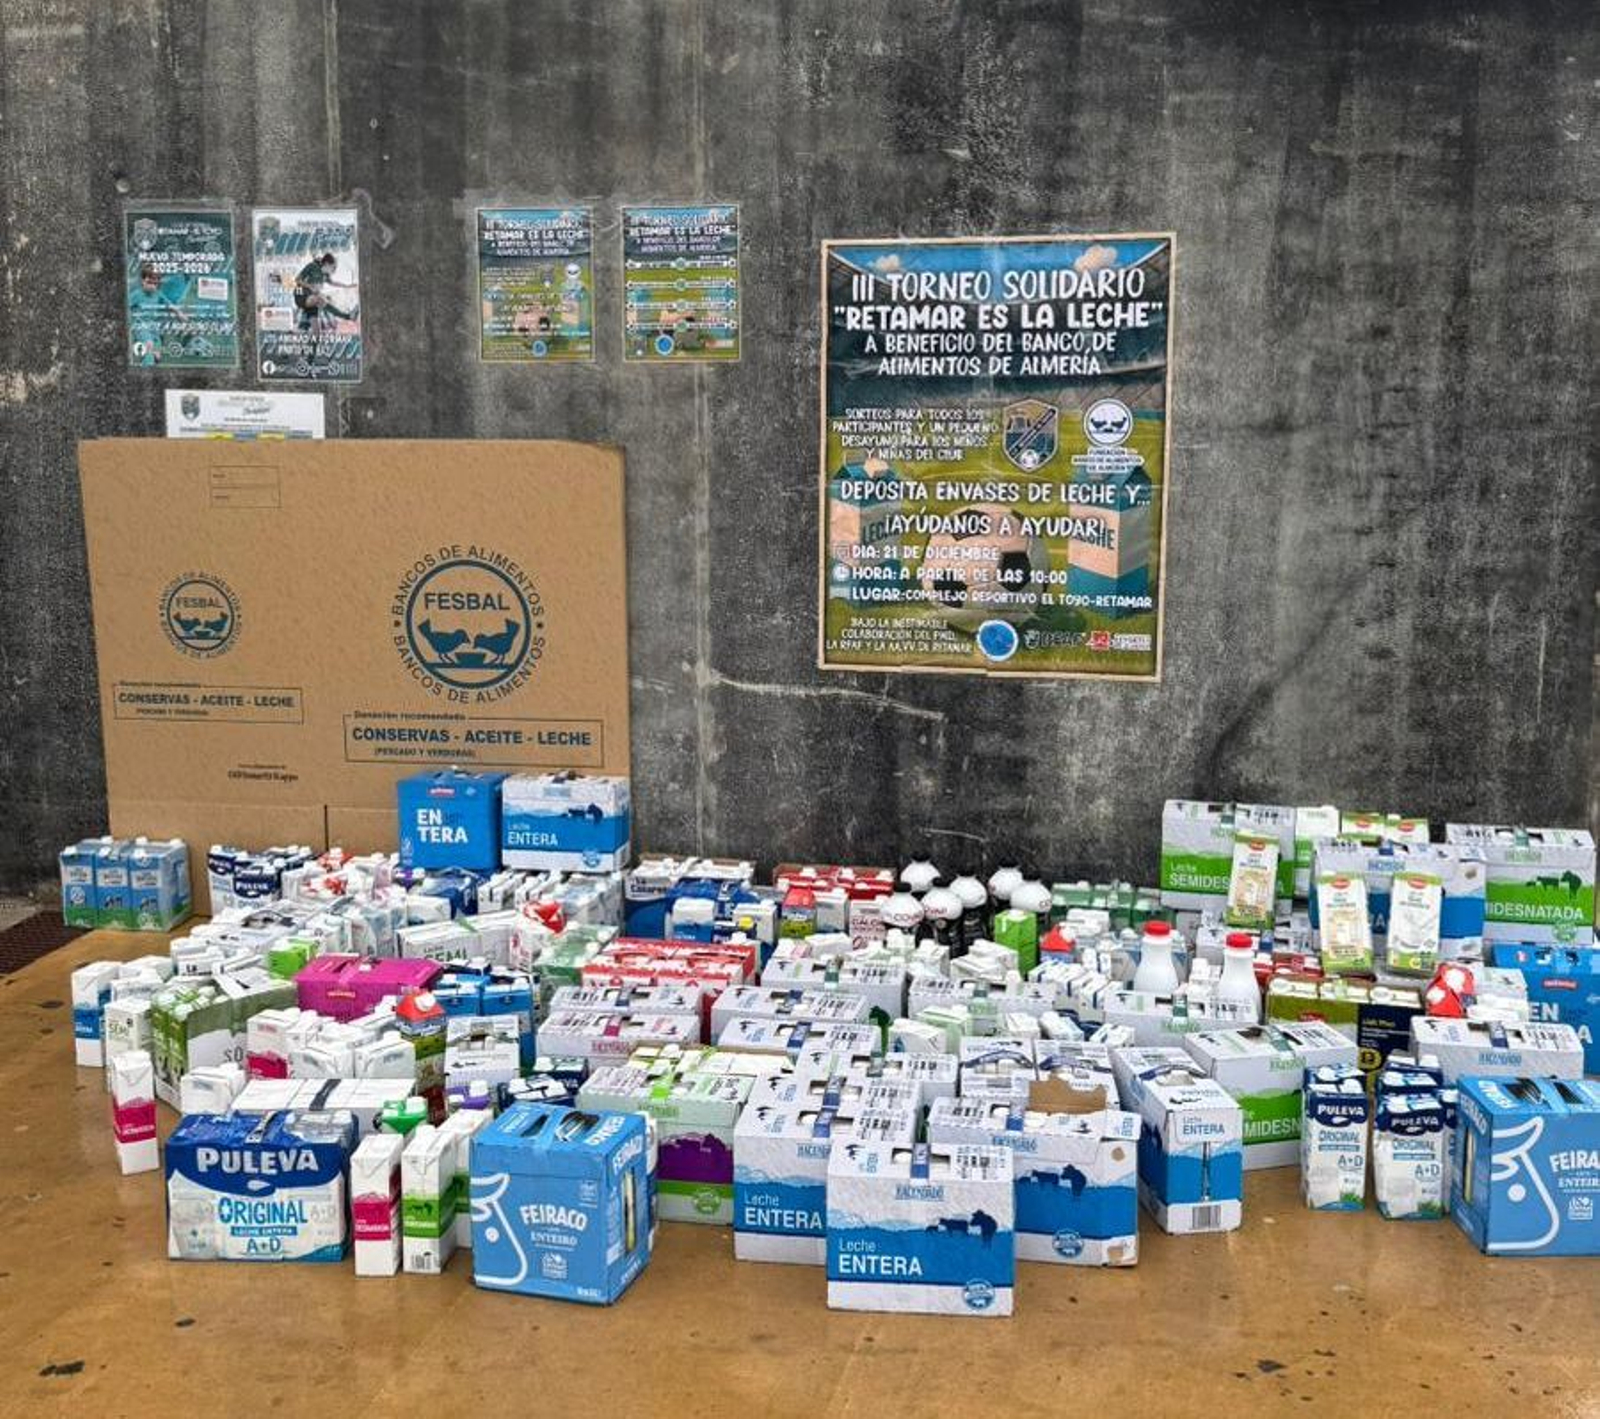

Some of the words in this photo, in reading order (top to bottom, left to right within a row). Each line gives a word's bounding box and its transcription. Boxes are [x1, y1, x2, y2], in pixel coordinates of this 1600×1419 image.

[852, 273, 874, 301] III
[886, 270, 991, 301] TORNEO
[1003, 267, 1146, 300] SOLIDARIO
[834, 304, 966, 330] "RETAMAR
[978, 303, 1009, 330] ES
[1020, 303, 1055, 329] LA
[1067, 302, 1163, 328] LECHE"
[865, 334, 878, 353] A
[885, 333, 975, 353] BENEFICIO
[982, 332, 1013, 353] DEL
[1022, 331, 1085, 352] BANCO
[1092, 331, 1117, 351] DE
[878, 356, 981, 376] ALIMENTOS
[989, 355, 1012, 375] DE
[1020, 348, 1101, 376] ALMERÍA
[845, 408, 891, 420] SORTEOS
[895, 408, 923, 420] PARA
[929, 408, 963, 420] TODOS
[967, 408, 984, 420] LOS
[833, 421, 912, 434] PARTICIPANTES
[918, 422, 927, 433] Y
[930, 422, 945, 433] UN
[841, 434, 898, 448] DESAYUNO
[901, 434, 927, 447] PARA
[932, 434, 950, 447] LOS
[866, 448, 876, 460] Y
[916, 448, 933, 460] DEL
[841, 480, 928, 500] DEPOSITA
[936, 481, 1020, 502] ENVASES
[1028, 483, 1052, 502] DE
[1061, 484, 1116, 504] LECHE
[885, 506, 992, 534] ¡AYÚDANOS
[999, 518, 1012, 535] A
[1020, 517, 1105, 537] AYUDAR!
[883, 545, 896, 559] 21
[903, 545, 921, 559] DE
[925, 546, 1000, 561] DICIEMBRE
[392, 553, 436, 616] BANCOS
[439, 544, 462, 561] DE
[468, 544, 546, 618] ALIMENTOS
[852, 566, 897, 580] HORA:
[900, 567, 910, 580] A
[916, 568, 966, 582] PARTIR
[973, 569, 989, 582] DE
[996, 569, 1023, 583] LAS
[1030, 570, 1068, 584] 10:00
[175, 596, 224, 609] FESBAL
[424, 591, 511, 612] FESBAL
[1041, 594, 1055, 605] EL
[1059, 594, 1153, 608] TOYO-RETAMAR
[878, 618, 890, 628] LA
[914, 630, 931, 640] DEL
[826, 640, 838, 649] LA
[874, 641, 886, 651] LA
[393, 635, 444, 697] BANCOS
[447, 687, 470, 704] DE
[475, 635, 547, 704] ALIMENTOS
[119, 692, 190, 706] CONSERVAS
[200, 694, 244, 707] ACEITE
[254, 696, 295, 708] LECHE
[352, 727, 450, 742] CONSERVAS
[465, 730, 523, 744] ACEITE
[538, 731, 591, 746] LECHE
[418, 748, 424, 756] Y
[417, 808, 443, 825] EN
[417, 826, 468, 843] TERA
[507, 831, 558, 847] ENTERA
[1530, 1002, 1559, 1021] EN
[1317, 1104, 1365, 1116] PULEVA
[1392, 1116, 1439, 1127] PULEVA
[1183, 1125, 1225, 1135] ENTERA
[196, 1147, 319, 1176] PULEVA
[1549, 1150, 1600, 1172] FEIRA
[745, 1190, 779, 1206] Leche
[218, 1197, 308, 1224] ORIGINAL
[520, 1204, 587, 1231] FEIRACO
[745, 1207, 822, 1229] ENTERA
[247, 1238, 282, 1252] A+D
[531, 1231, 578, 1246] ENTEIRO
[838, 1239, 876, 1252] Leche
[838, 1254, 922, 1276] ENTERA
